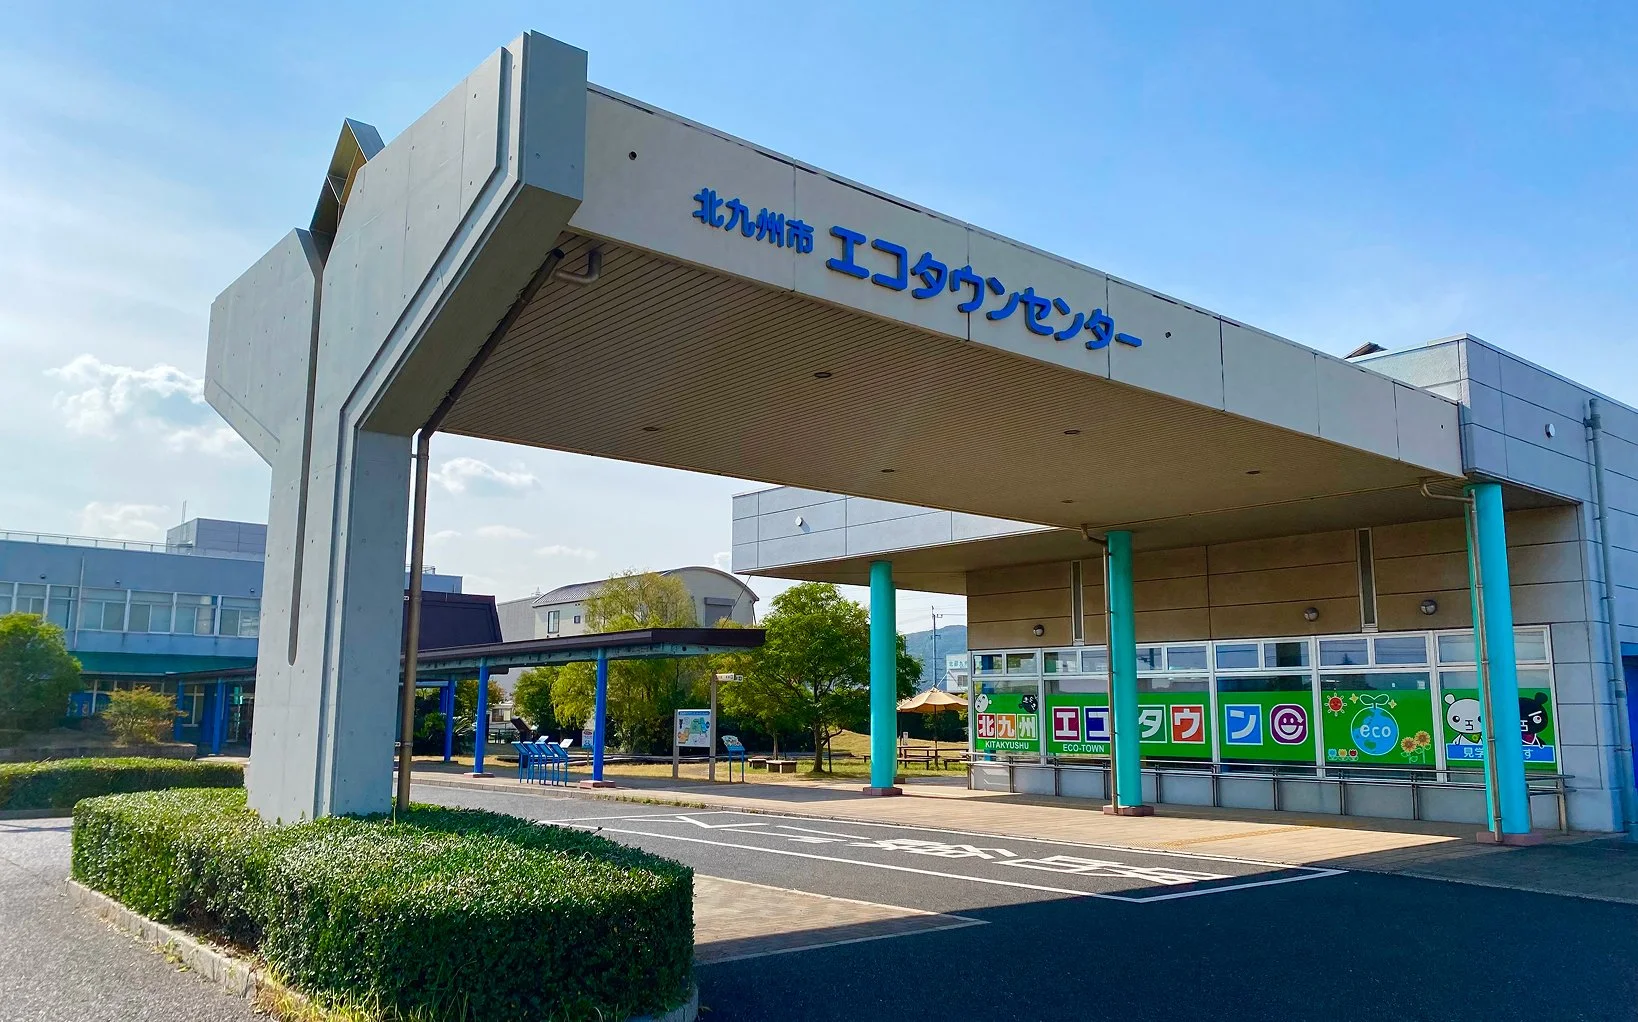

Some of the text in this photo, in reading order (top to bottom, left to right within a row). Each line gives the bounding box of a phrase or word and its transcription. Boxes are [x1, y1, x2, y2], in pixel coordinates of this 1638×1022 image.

[692, 187, 1142, 351] 北九州市 エコタウンセンター
[978, 715, 1036, 738] 北九州
[1359, 723, 1392, 738] eco
[985, 740, 1105, 753] KITAKYUSHU ECO-TOWN
